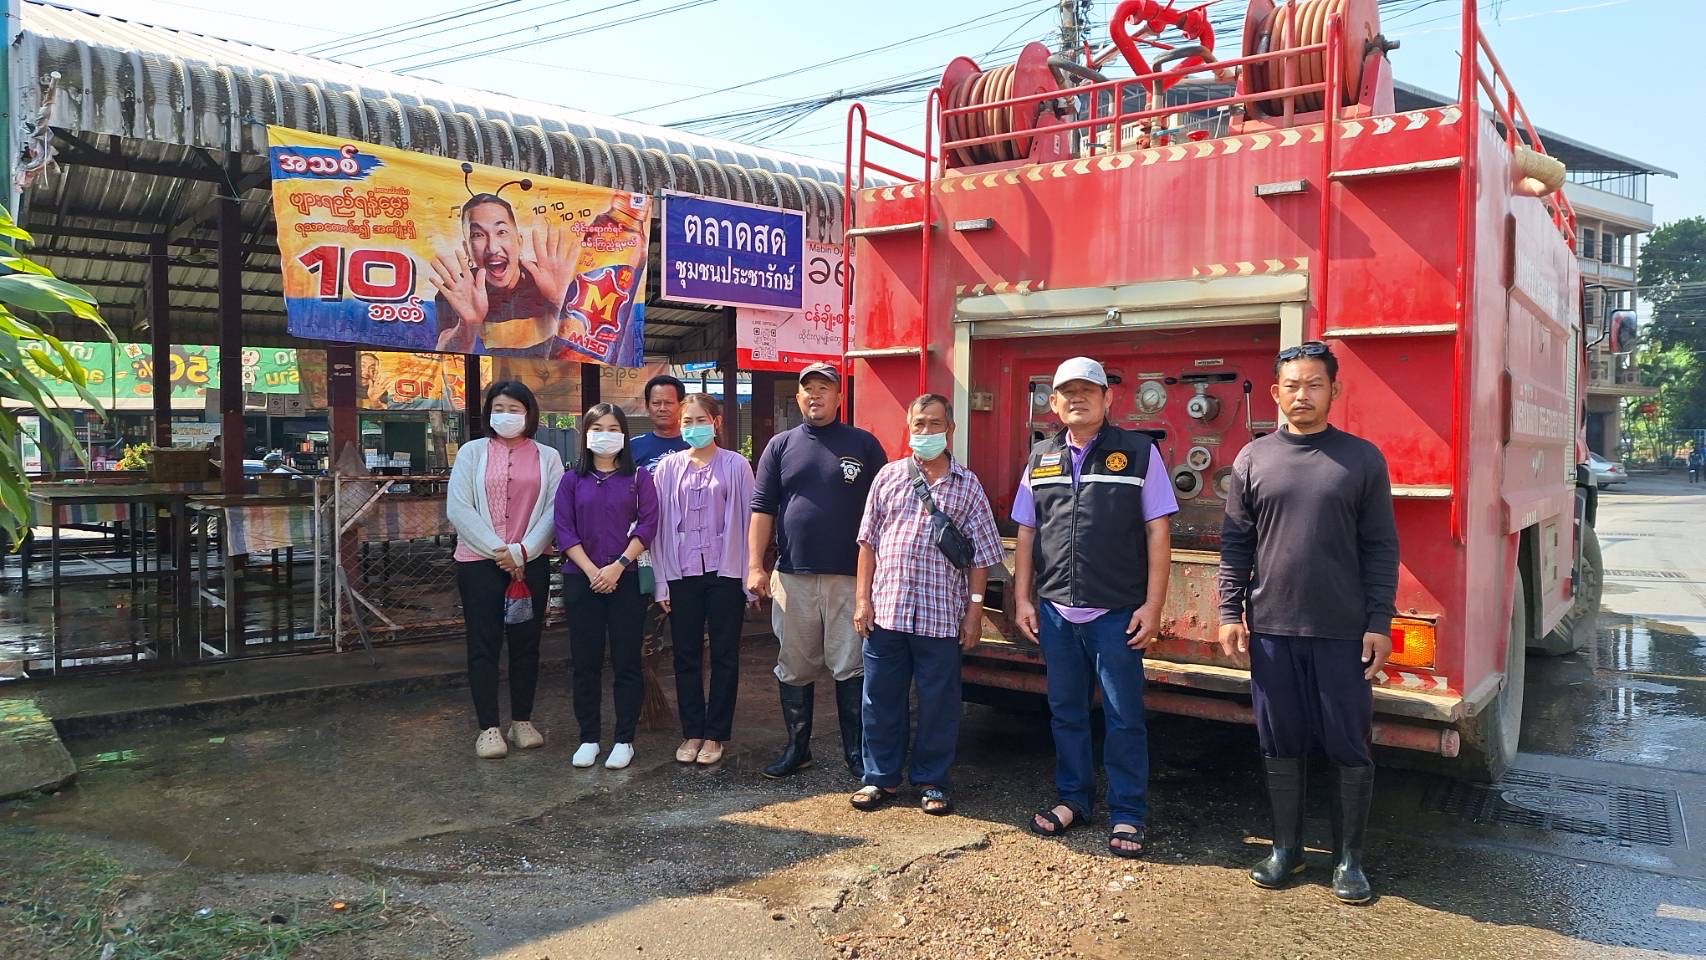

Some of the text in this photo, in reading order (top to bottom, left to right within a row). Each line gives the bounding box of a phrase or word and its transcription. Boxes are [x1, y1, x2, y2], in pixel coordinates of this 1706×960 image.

[278, 144, 360, 175] အသစ်
[532, 201, 565, 215] 10 10
[559, 208, 591, 222] 10 10
[684, 215, 786, 256] ตลาดสด
[809, 243, 832, 255] Mabin
[297, 244, 415, 302] 10
[675, 257, 795, 291] ชุมชนประชารักษ์
[368, 295, 425, 322] ဘတ်
[581, 283, 619, 321] M
